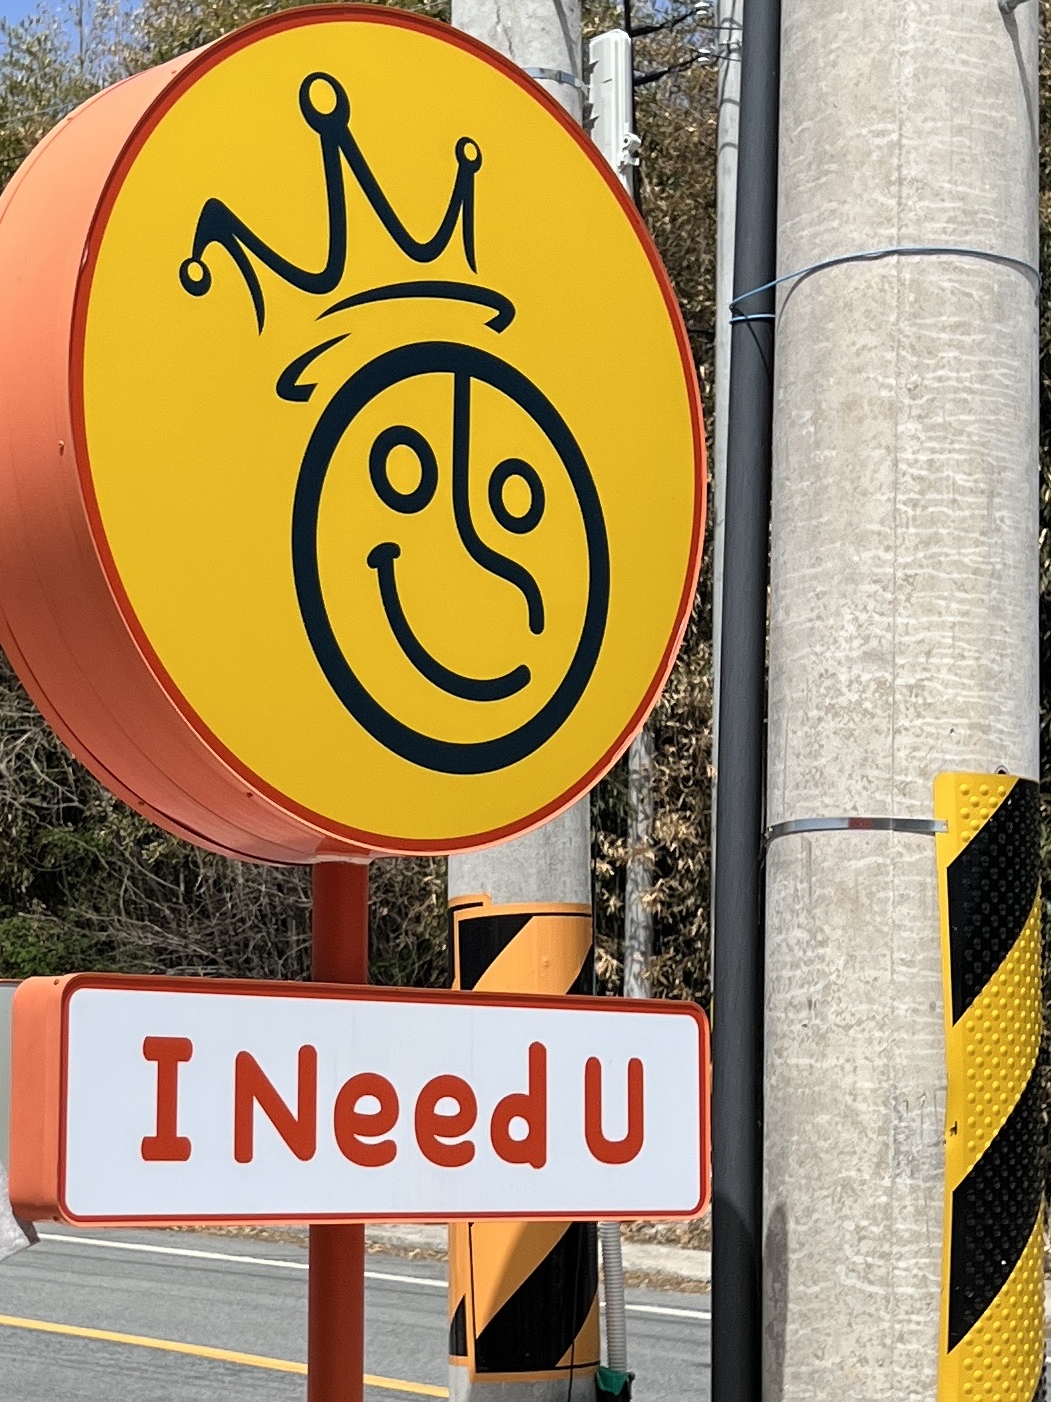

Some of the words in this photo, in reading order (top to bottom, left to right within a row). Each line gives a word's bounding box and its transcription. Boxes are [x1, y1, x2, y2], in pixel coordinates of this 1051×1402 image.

[141, 1036, 194, 1163] I
[233, 1041, 547, 1170] Need
[584, 1056, 645, 1166] U
